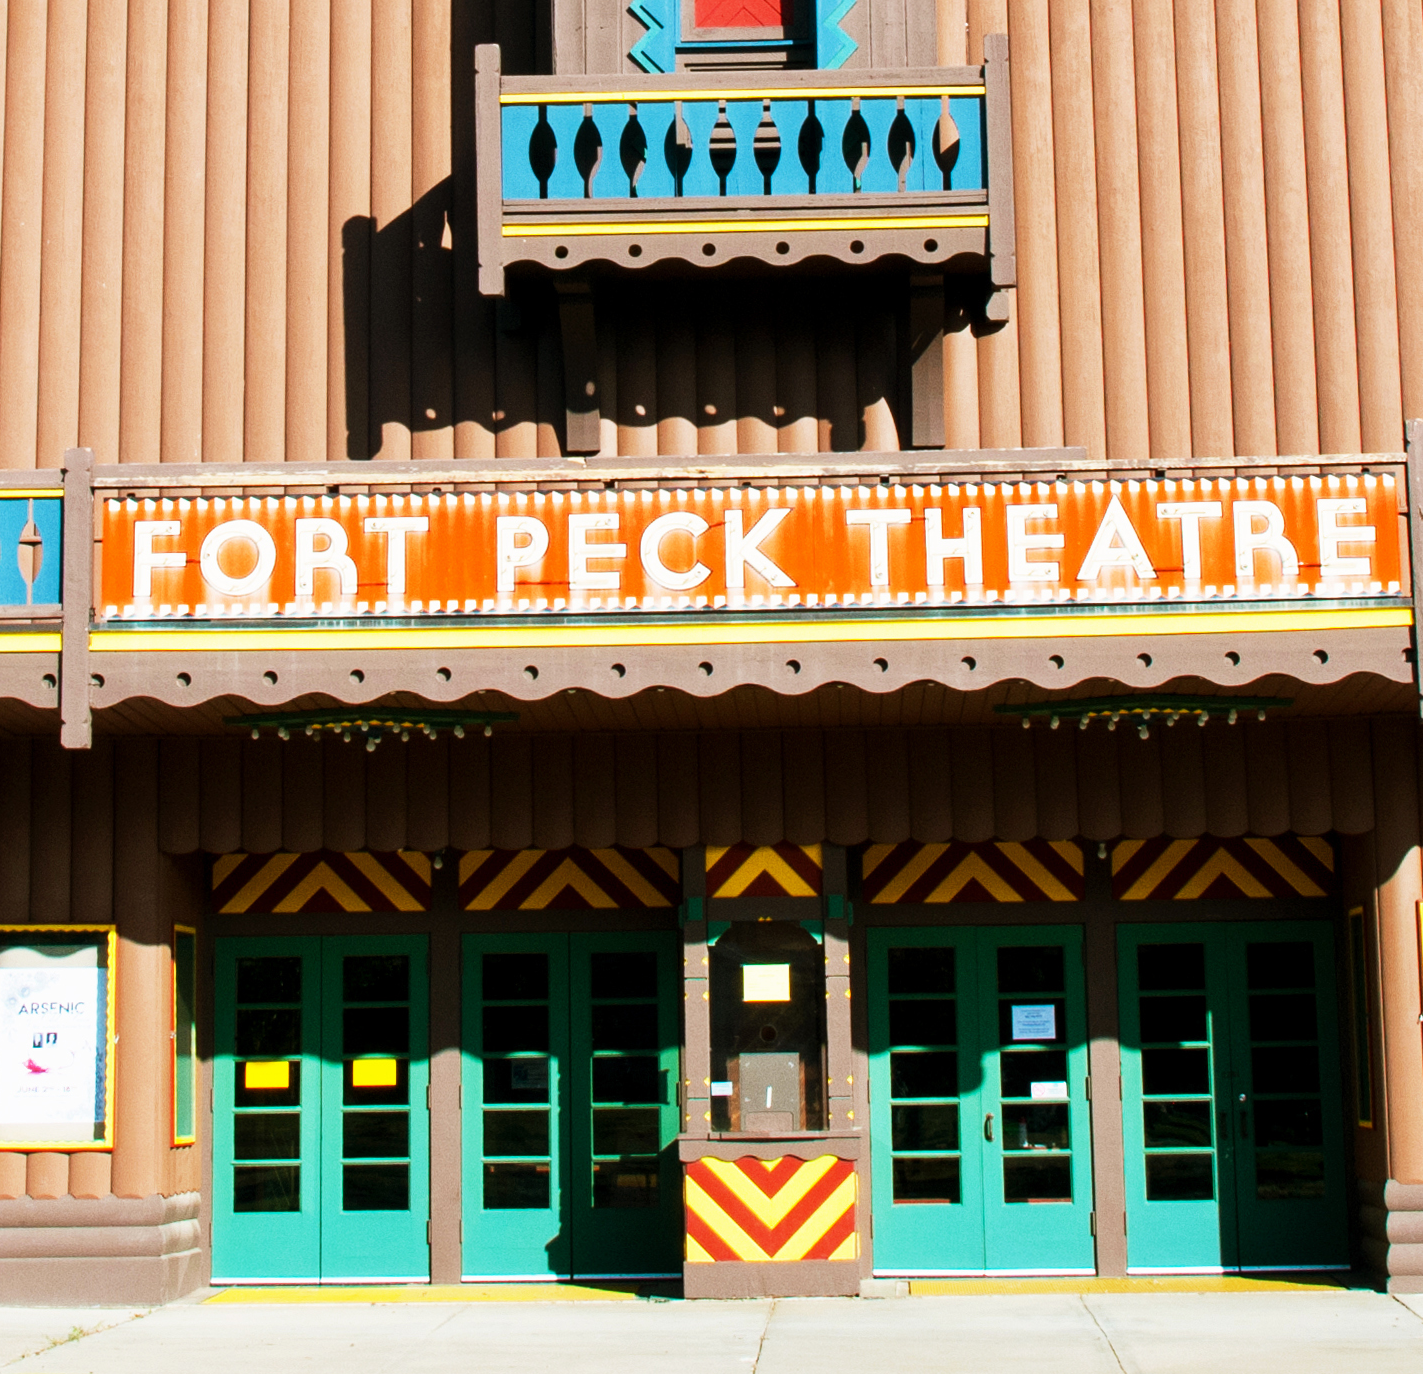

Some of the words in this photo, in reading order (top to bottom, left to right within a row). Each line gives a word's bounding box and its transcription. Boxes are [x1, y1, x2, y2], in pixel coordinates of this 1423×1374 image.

[131, 515, 429, 598] FORT
[495, 508, 799, 592] PECK
[845, 493, 1377, 586] THEATRE
